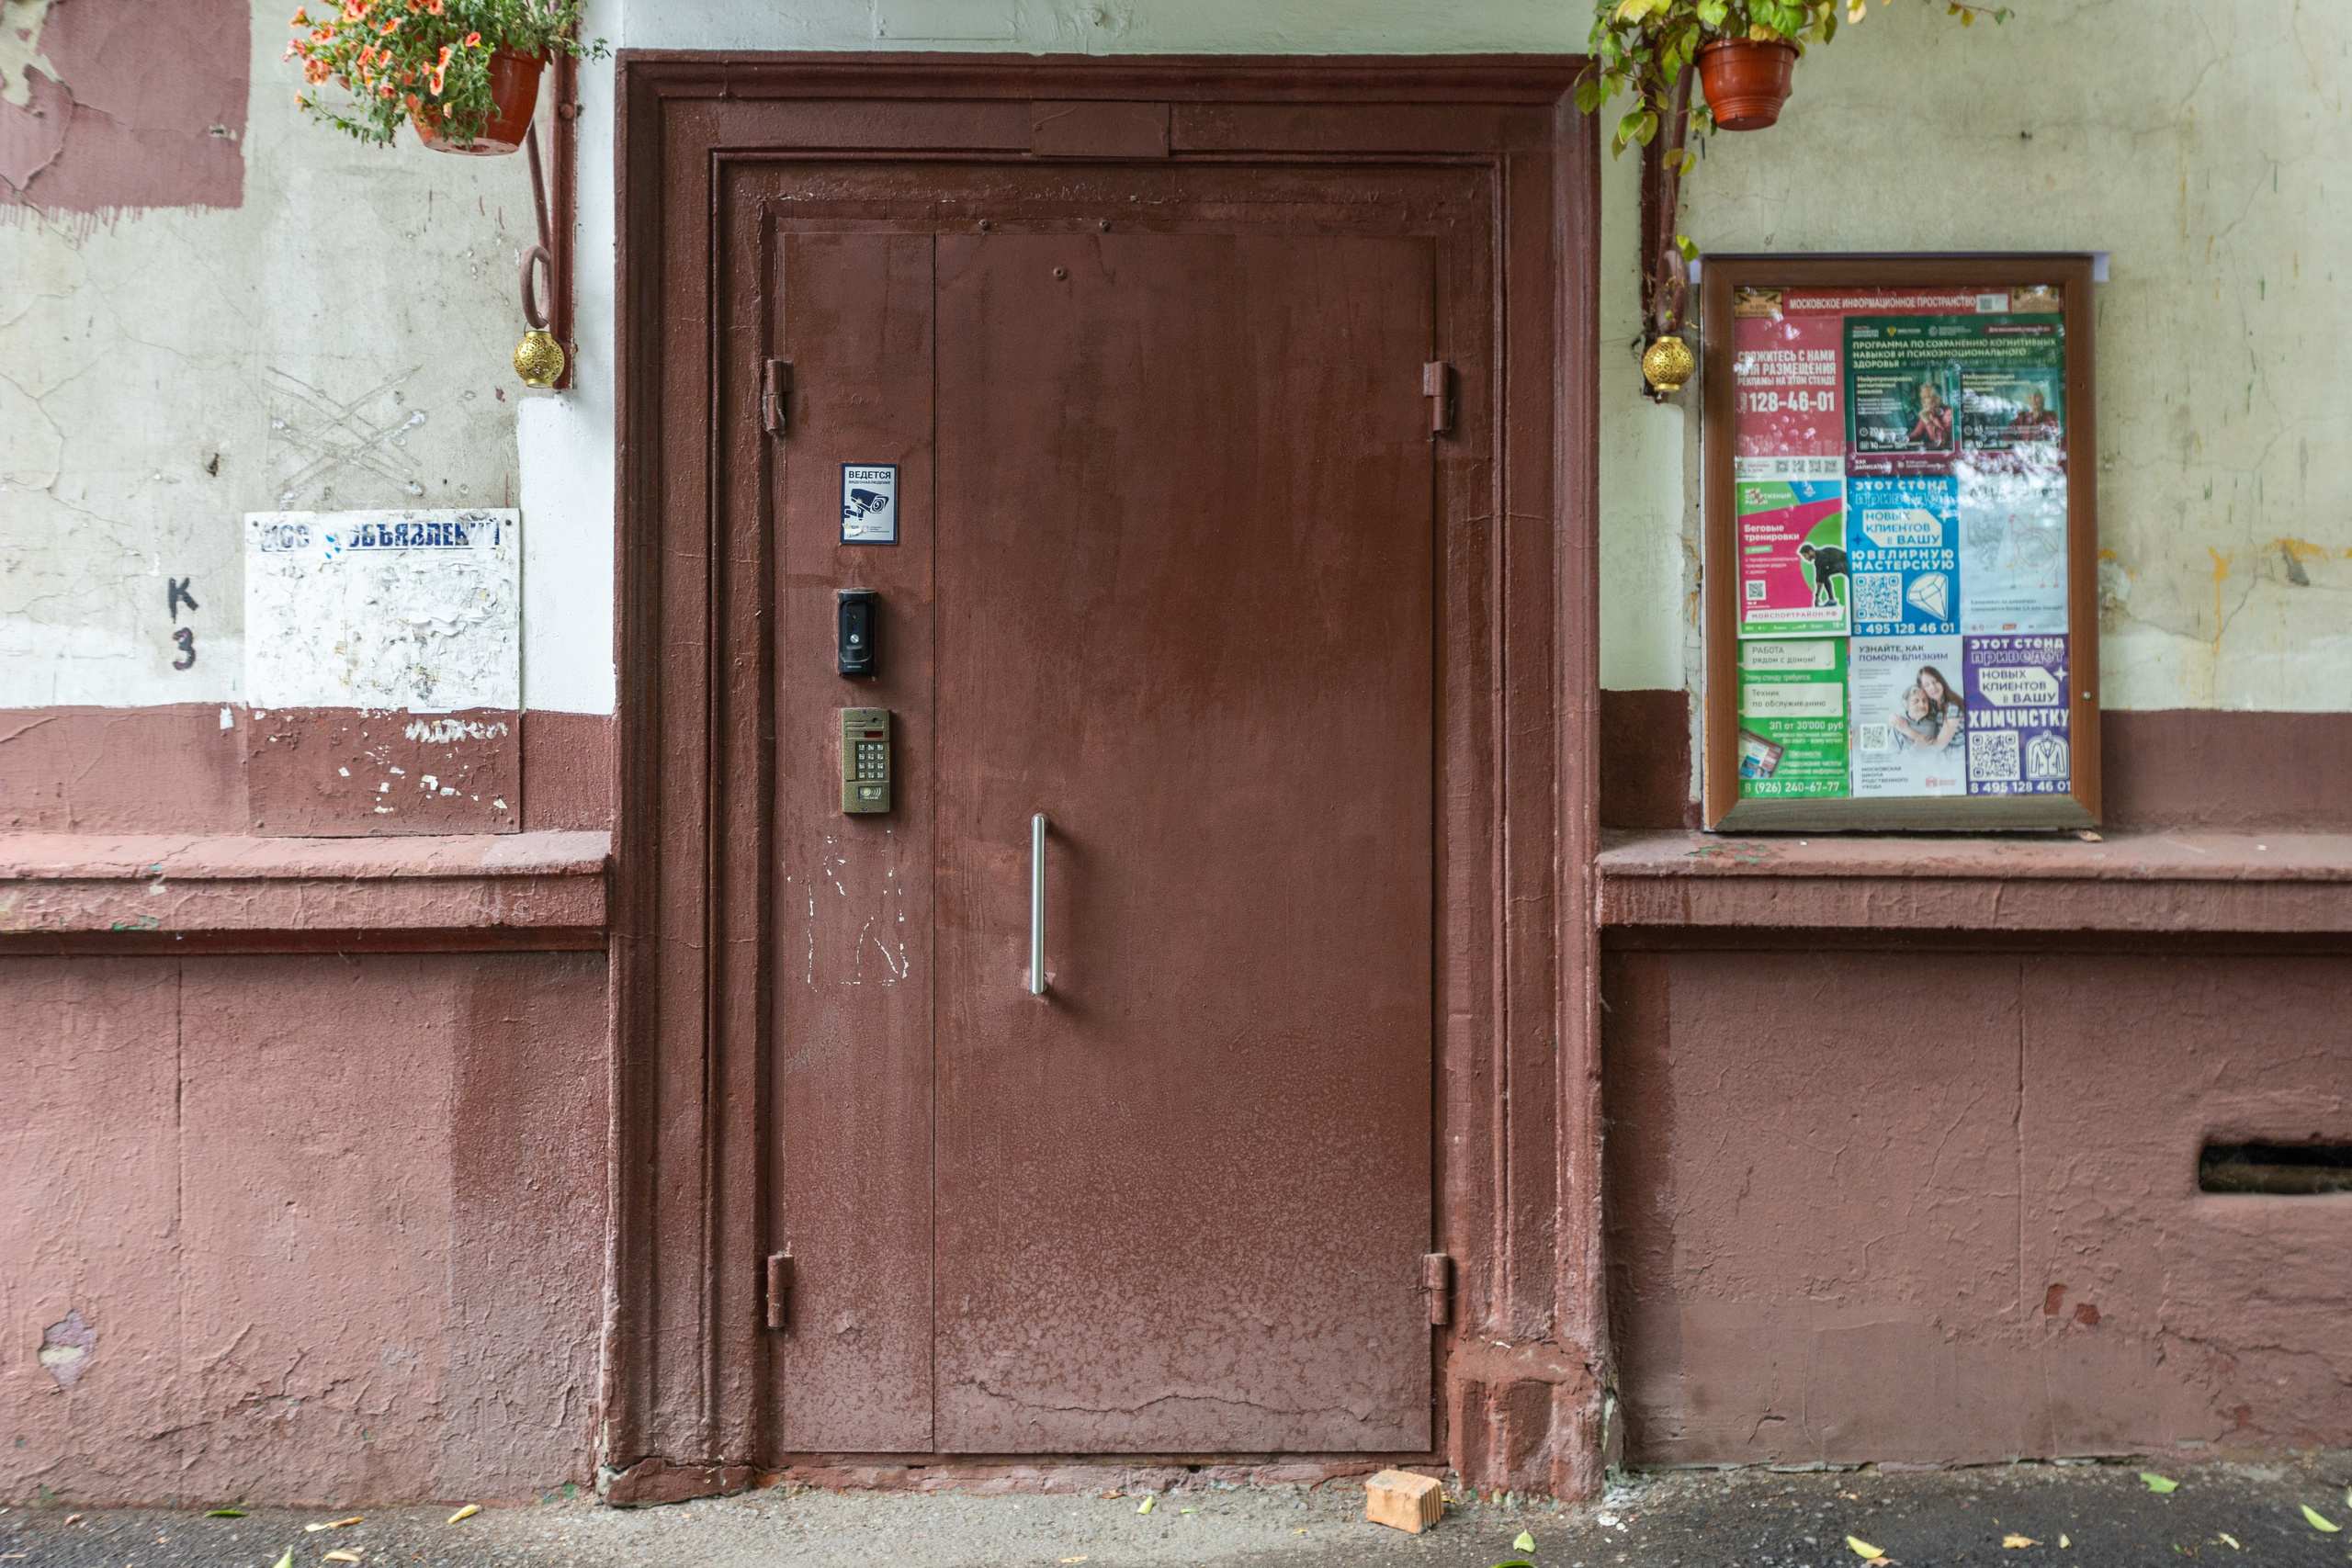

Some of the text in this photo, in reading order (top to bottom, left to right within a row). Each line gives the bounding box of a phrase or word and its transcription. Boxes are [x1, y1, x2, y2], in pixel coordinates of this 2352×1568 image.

[1790, 296, 1976, 310] МОСКОВСКОЕ ИНФОРМАЦИОННОЕ ПРОСТРАНСТВО
[1853, 338, 2056, 349] ПРОГРАММА ПО СОХРАНЕНИЮ КОГНИТИВНЫХ
[1738, 350, 1836, 362] СВЯЖИТЕСЬ С НАМИ
[1853, 348, 2027, 359] НАВЫКОВ И ПСИХОЭМОЦИОНАЛЬНОГО
[1853, 359, 1899, 369] ЗДОРОВЬЯ
[1737, 363, 1837, 377] ЛЯ РАЗМЕЩЕНИЯ
[1737, 376, 1837, 386] РЕКЛАМЫ НА ЭТОМ СТЕНДЕ
[1748, 391, 1835, 412] 128-46-01
[849, 470, 891, 480] ВЕДЕТСЯ
[1866, 512, 1910, 522] НОВЫХ
[1745, 525, 1784, 533] Беговые
[1866, 523, 1931, 534] КЛИЕНТОВ
[1745, 533, 1800, 542] тренировки
[1897, 534, 1940, 545] ВАШУ
[1851, 549, 1954, 560] ЮВЕЛИРНУЮ
[1851, 559, 1954, 571] МАСТЕРСКУЮ
[1752, 610, 1837, 619] МОЙСПОРТРАЙОН.РФ
[1854, 623, 1955, 634] 8 495 128 46 01
[1752, 646, 1784, 654] РАБОТА
[1859, 644, 1925, 653] УЗНАЙТЕ, КАК
[1752, 656, 1778, 665] рядом
[1787, 656, 1816, 664] домом!
[1859, 652, 1949, 662] ПОМОЧЬ БЛИЗКИМ
[1982, 670, 2027, 680] НОВЫХ
[1982, 682, 2047, 692] КЛИЕНТОВ
[1752, 689, 1780, 697] Техник
[2013, 693, 2057, 704] ВАШУ
[1765, 699, 1826, 710] обслуживанию
[1968, 708, 2070, 728] ХИМЧИСТКУ
[1770, 721, 1782, 730] ЗП
[1828, 721, 1844, 732] руб
[1745, 781, 1840, 794] 8 (926) 240-67-77
[1971, 782, 1979, 793] 8
[1983, 782, 2007, 793] 495
[2012, 782, 2033, 793] 128
[2037, 781, 2054, 792] 46
[2057, 781, 2071, 792] 01
